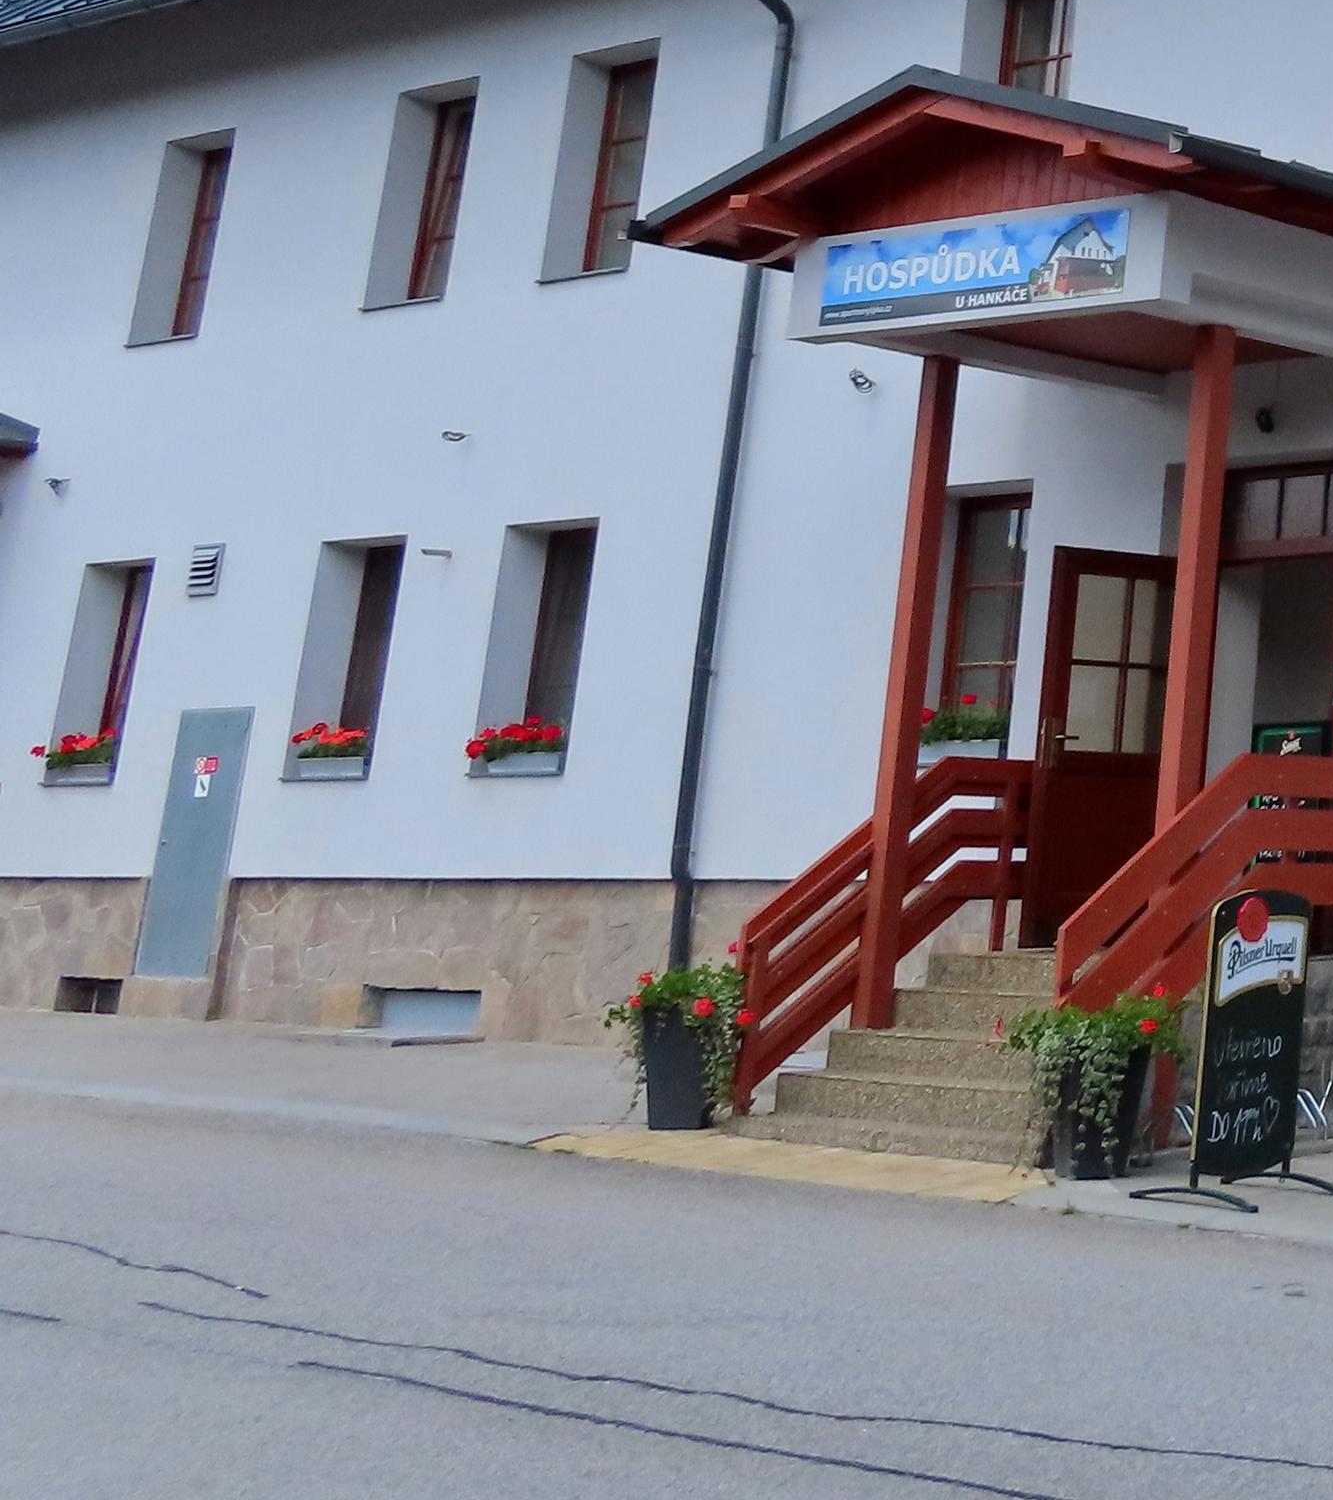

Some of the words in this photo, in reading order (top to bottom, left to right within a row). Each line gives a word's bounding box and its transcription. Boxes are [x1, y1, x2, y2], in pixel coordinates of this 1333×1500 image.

[843, 245, 1020, 295] HOSPŮDKA
[955, 296, 966, 309] U
[969, 289, 1028, 307] HANKÁČE
[1227, 940, 1264, 980] Pilsner
[1264, 938, 1298, 964] Urquell
